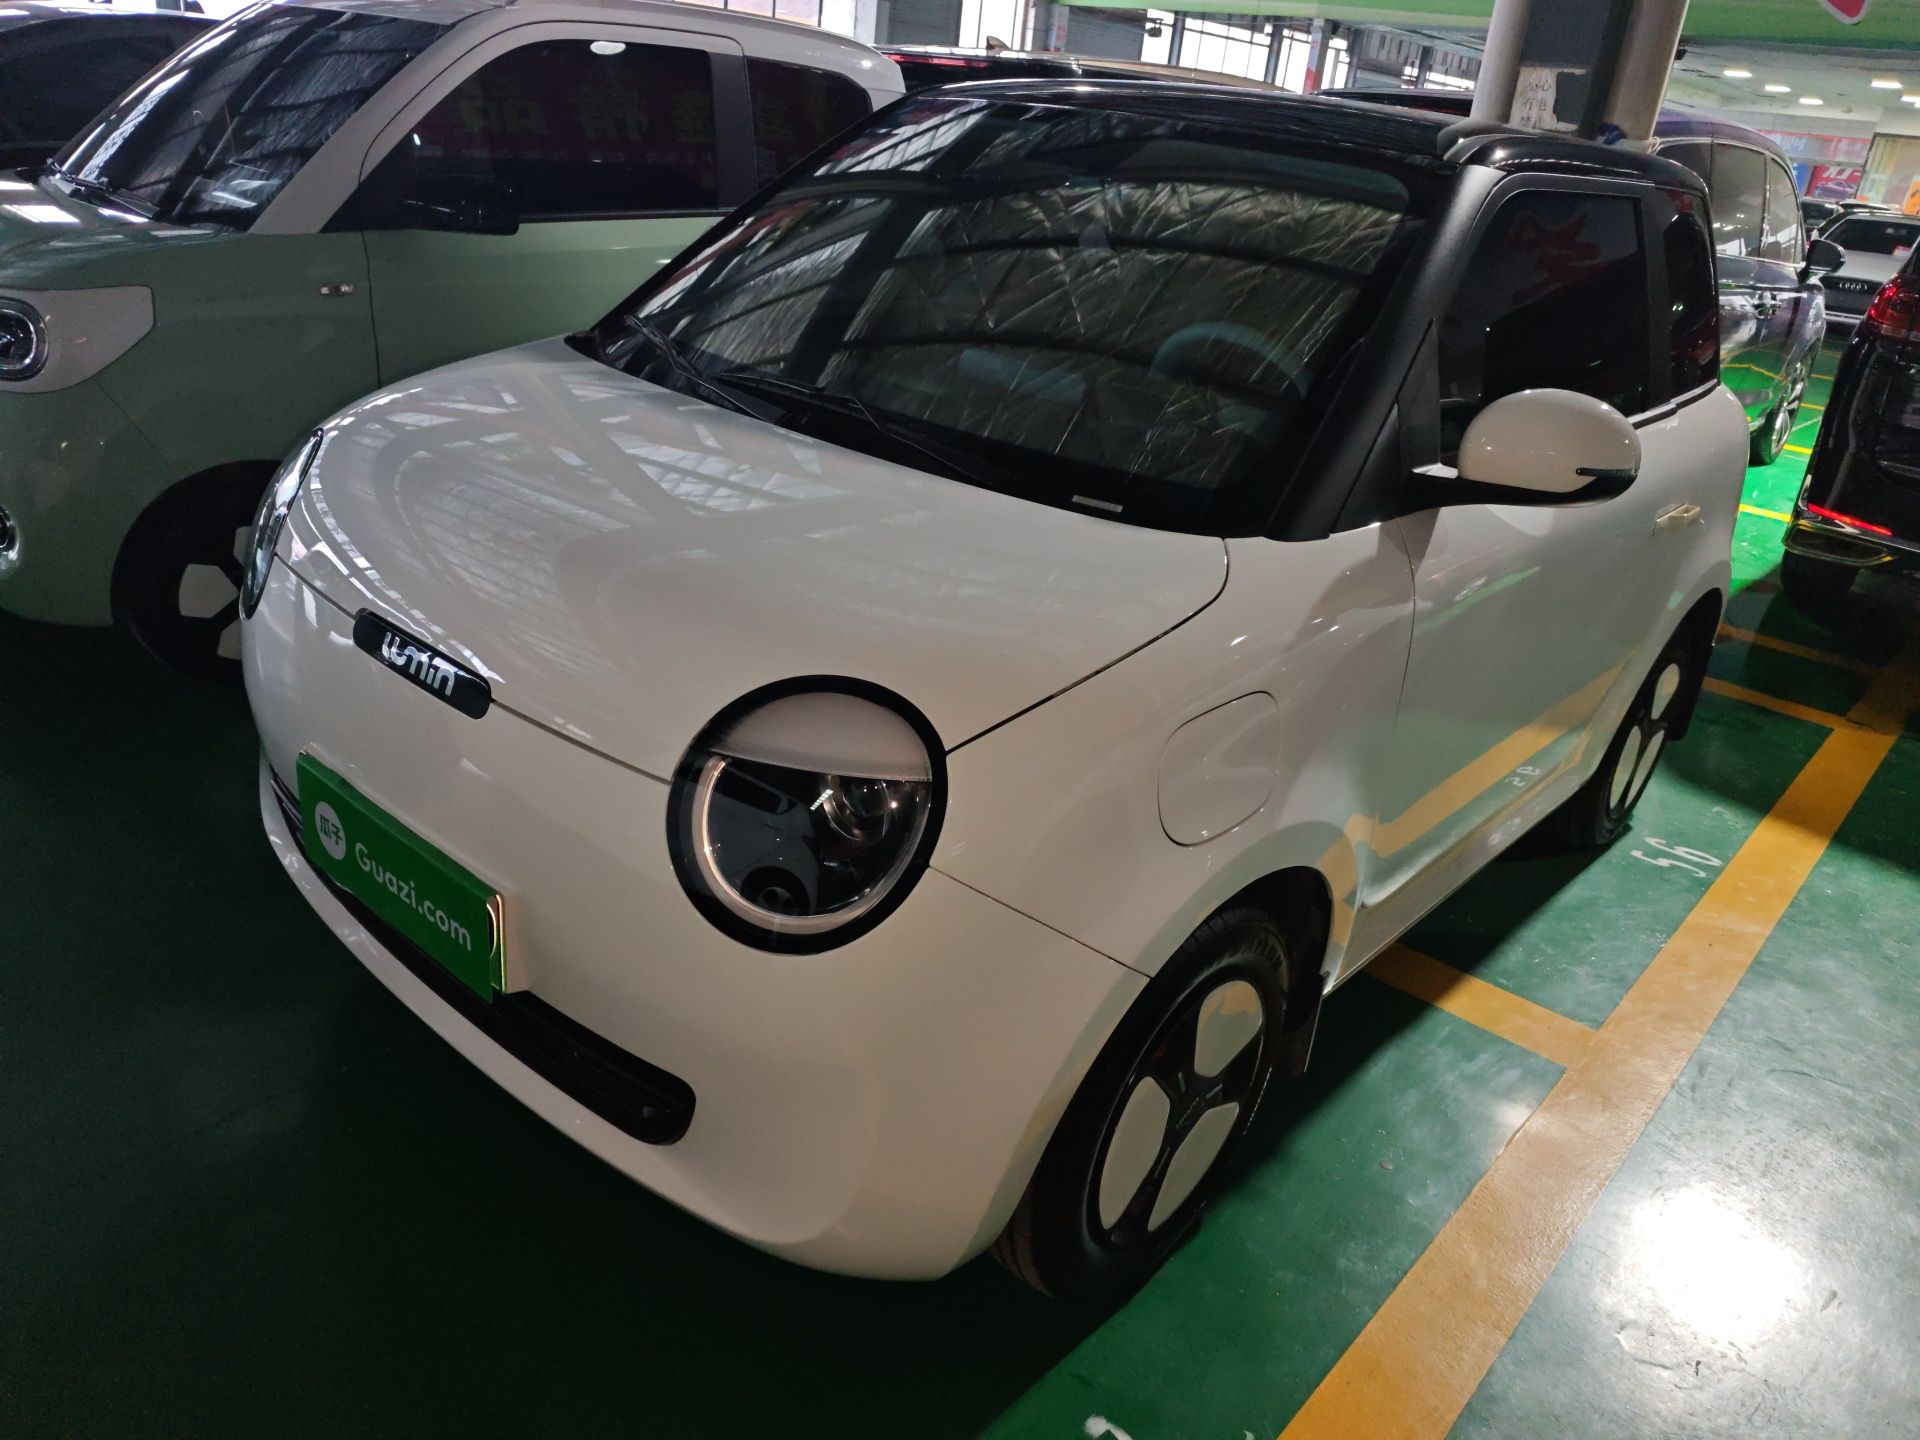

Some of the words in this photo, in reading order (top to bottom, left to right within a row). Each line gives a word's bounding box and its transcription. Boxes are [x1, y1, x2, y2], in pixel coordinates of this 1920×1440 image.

[319, 814, 343, 845] 瓜子
[1630, 836, 1724, 878] 56
[355, 842, 472, 951] Guazi.com
